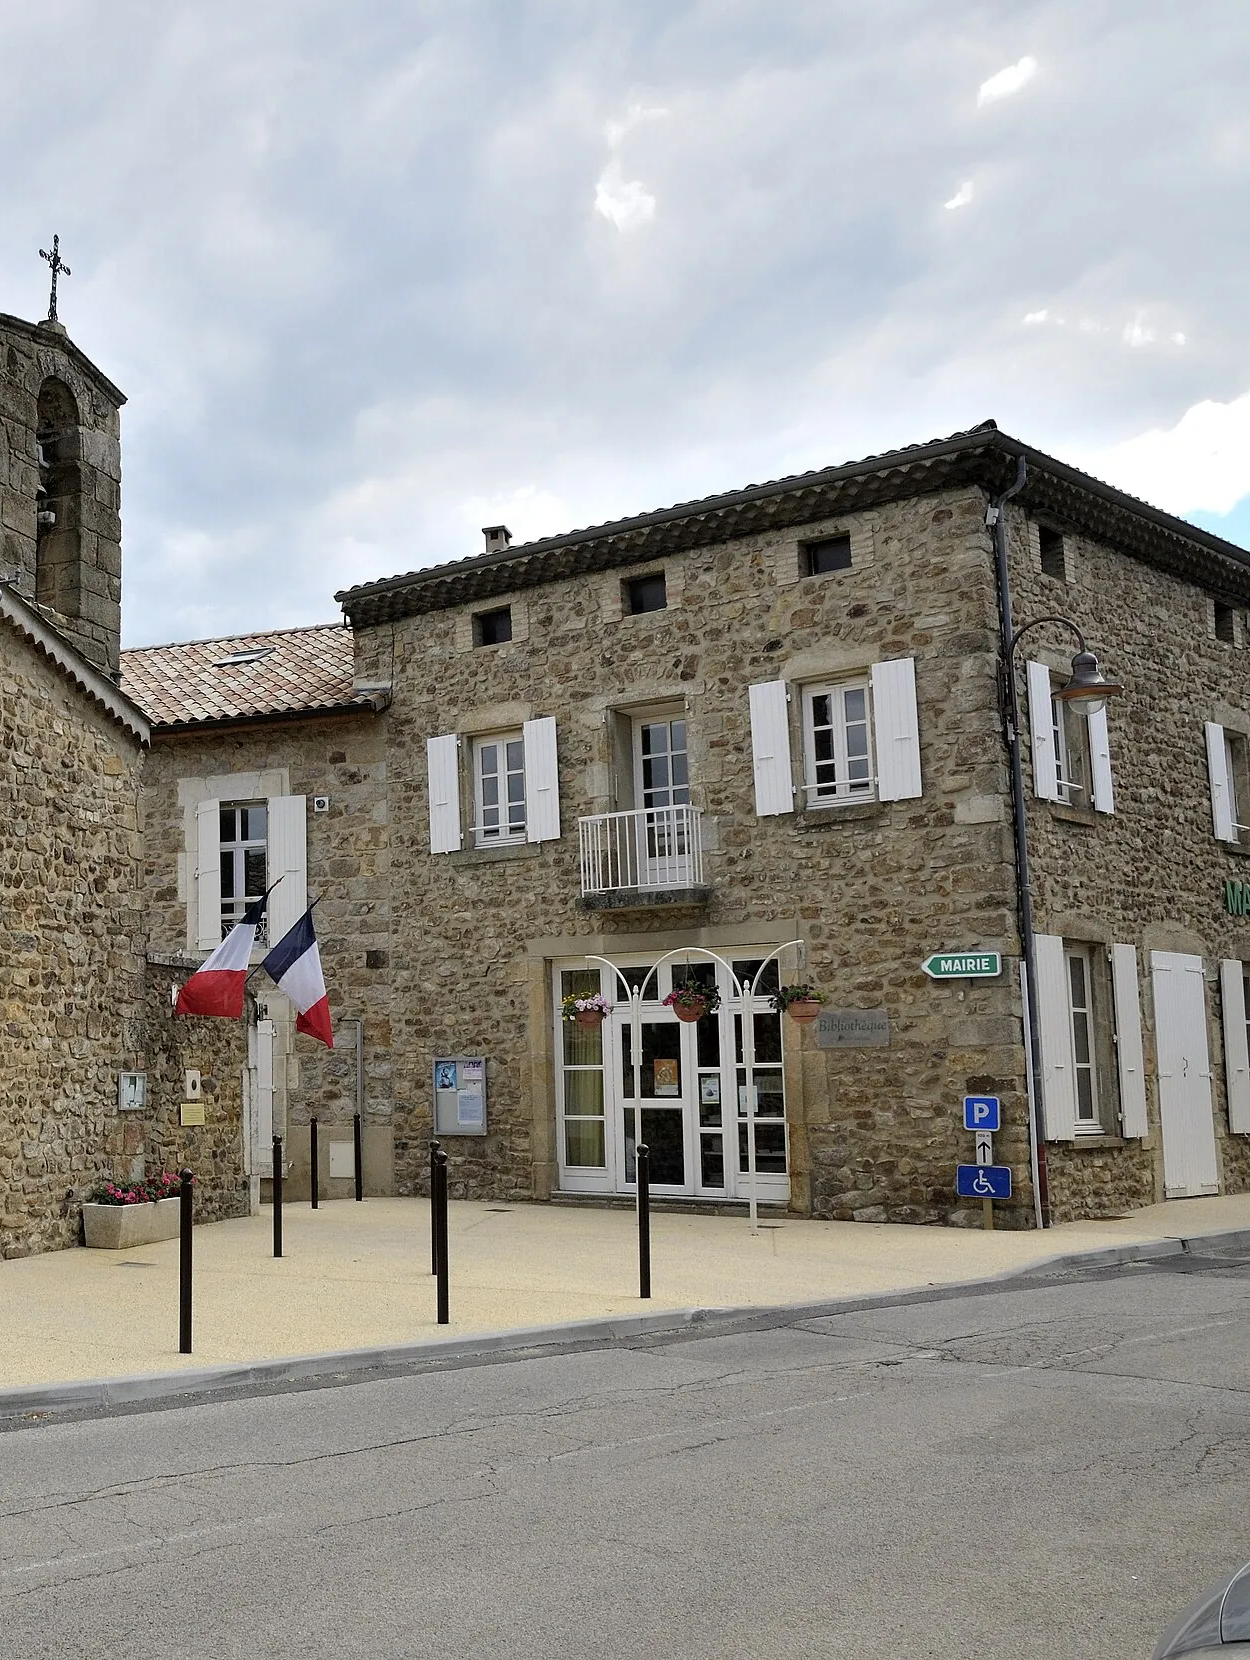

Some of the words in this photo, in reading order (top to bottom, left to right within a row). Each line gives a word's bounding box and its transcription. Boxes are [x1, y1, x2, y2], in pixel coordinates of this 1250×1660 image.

[940, 958, 990, 972] MAIRIE
[819, 1018, 887, 1033] Bibliothèque
[973, 1103, 990, 1123] P
